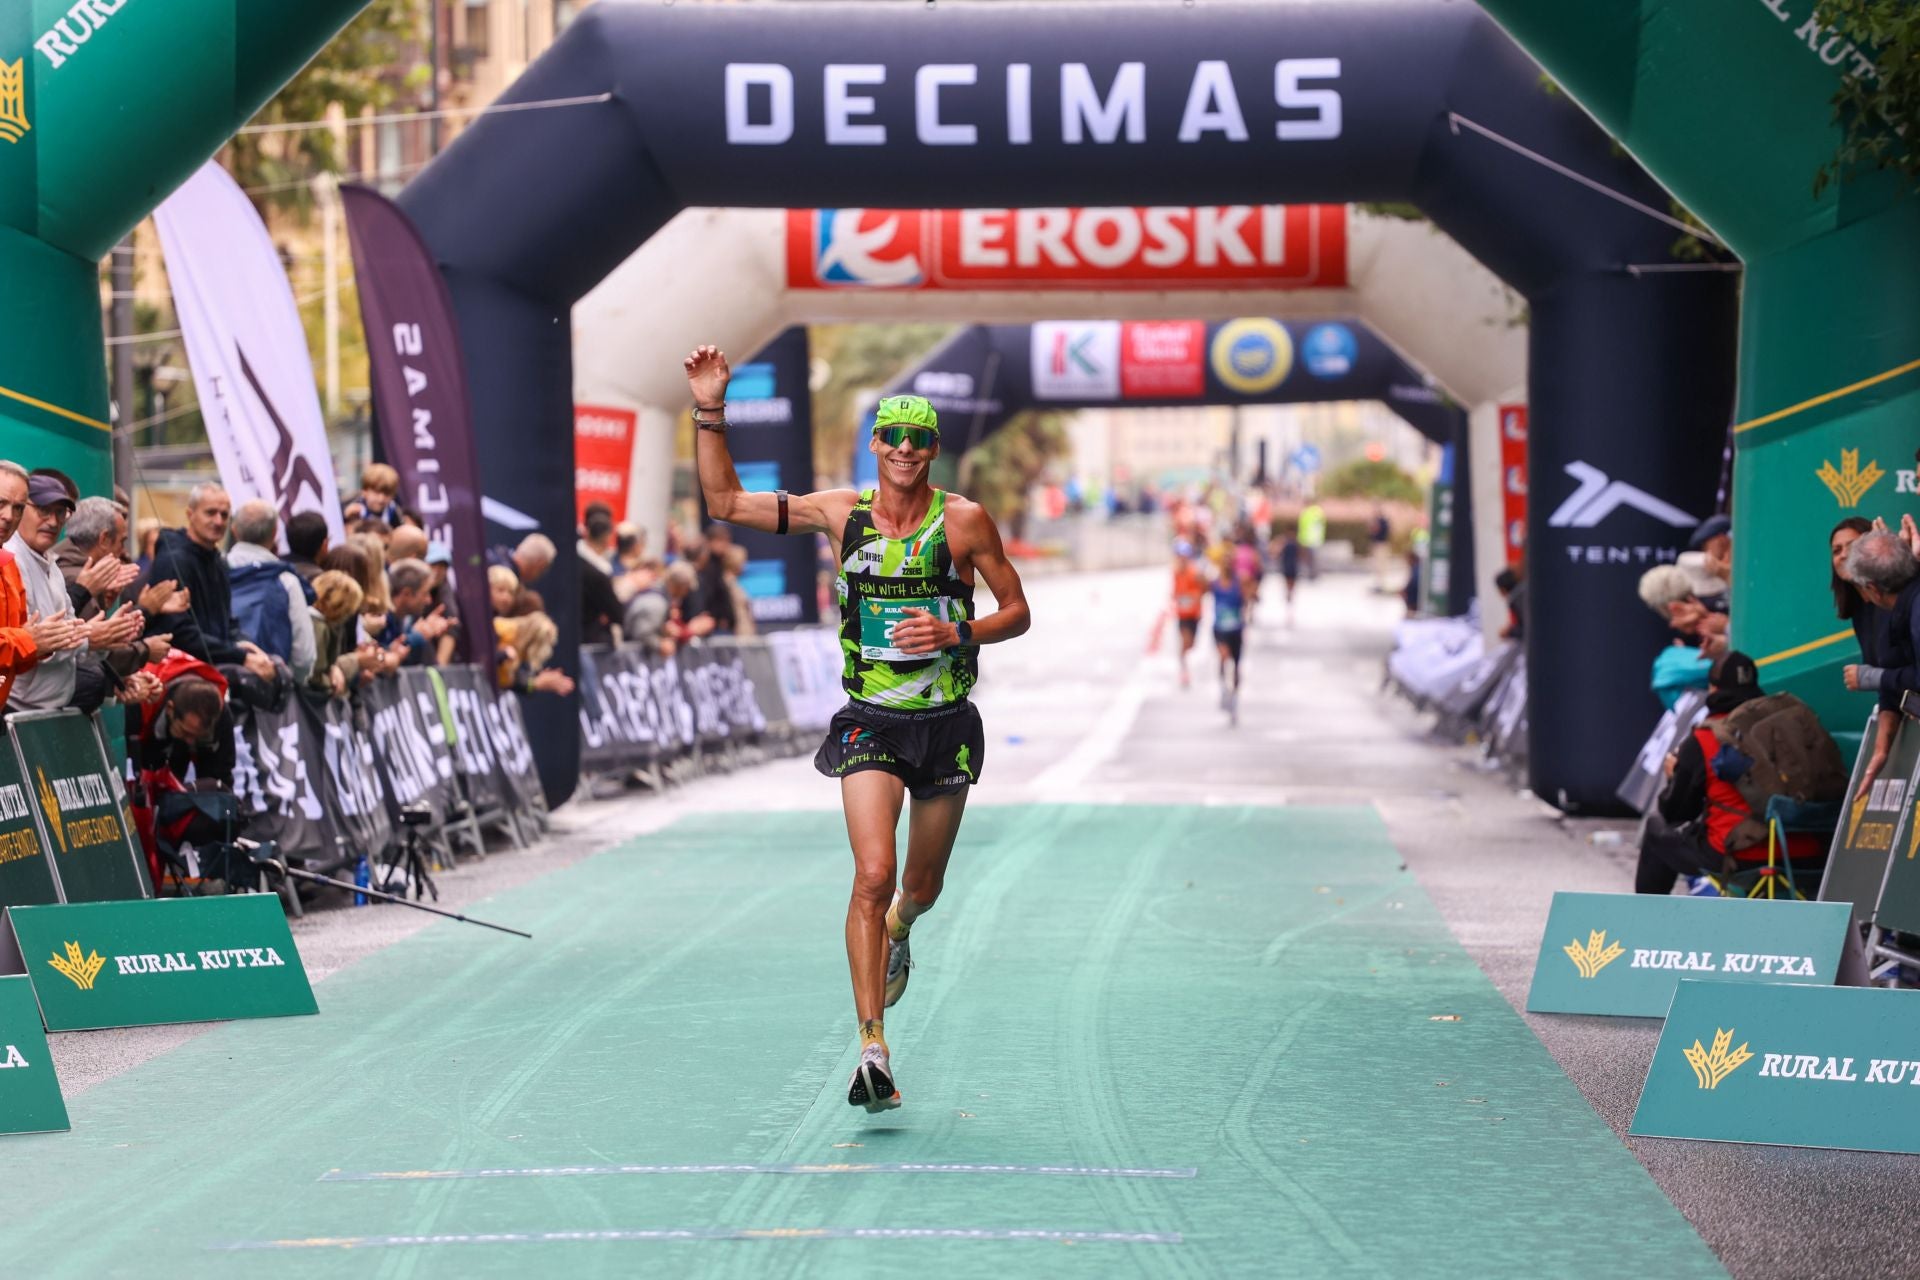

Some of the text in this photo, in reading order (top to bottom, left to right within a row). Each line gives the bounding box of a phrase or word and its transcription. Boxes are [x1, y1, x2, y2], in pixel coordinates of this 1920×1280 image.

[33, 0, 128, 69] RUR
[724, 58, 1342, 145] DECIMAS
[958, 205, 1287, 269] EROSKI
[1566, 545, 1677, 564] TENTH
[878, 583, 906, 596] WITH
[847, 752, 869, 766] WITH
[77, 772, 112, 808] KUTXA
[114, 947, 285, 975] RURAL KUTXA
[1630, 949, 1817, 976] RURAL KUTXA
[1758, 1053, 1858, 1081] RURAL
